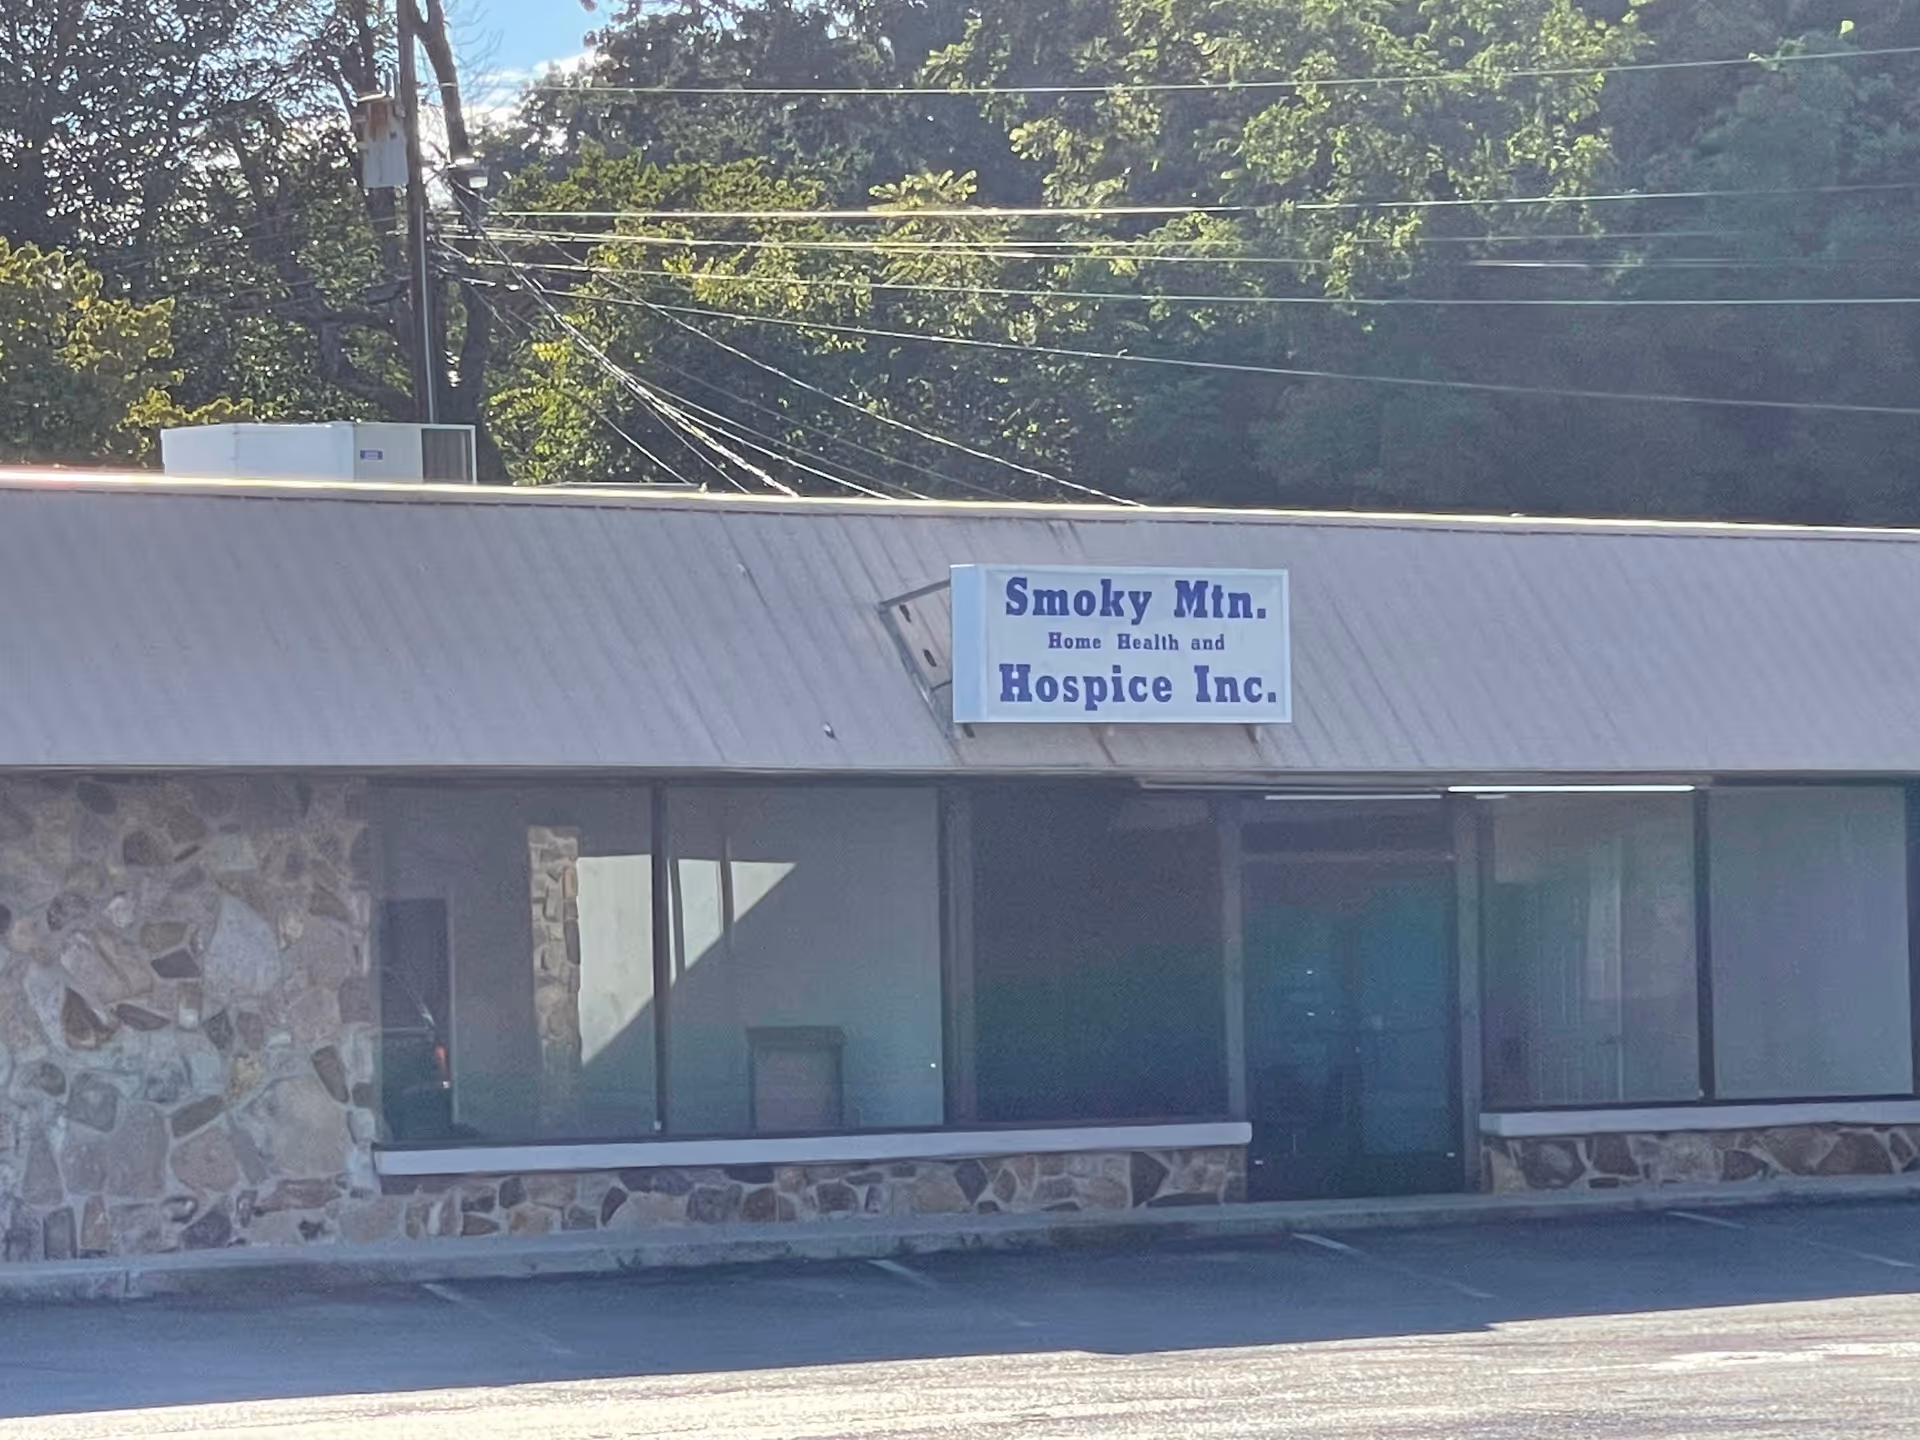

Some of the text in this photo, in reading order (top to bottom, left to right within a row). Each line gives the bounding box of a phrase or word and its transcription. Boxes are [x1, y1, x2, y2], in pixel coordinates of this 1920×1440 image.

[1005, 576, 1267, 625] Smoky Mtn.
[1048, 632, 1226, 651] Home Health and
[999, 663, 1277, 711] Hospice Inc.
